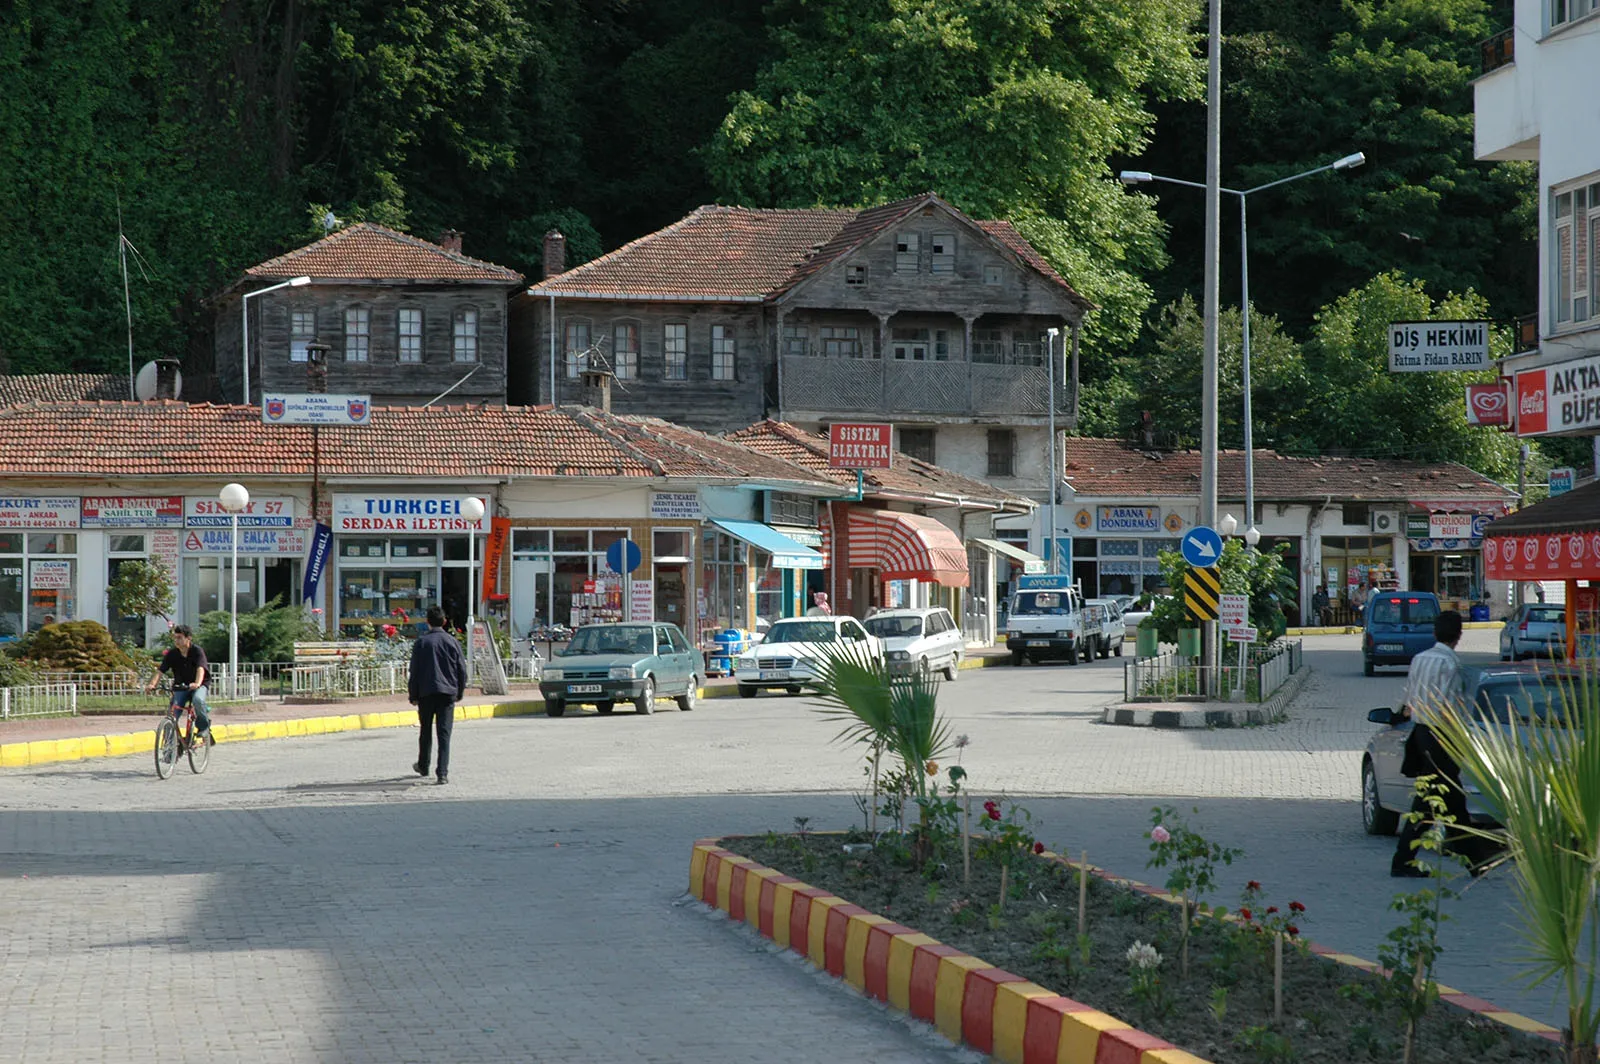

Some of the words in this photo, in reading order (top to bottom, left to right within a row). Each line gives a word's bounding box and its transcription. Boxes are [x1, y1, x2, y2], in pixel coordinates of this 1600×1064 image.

[1394, 326, 1419, 351] DİŞ
[1427, 324, 1483, 347] HEKİMİ
[1394, 354, 1421, 366] Fatma
[1424, 352, 1449, 365] Fidan
[1451, 351, 1484, 365] BARIN
[1552, 365, 1600, 396] AKTA
[264, 502, 283, 514] 57
[1113, 508, 1144, 518] ABANA
[29, 511, 58, 519] ANKARA
[342, 517, 407, 530] SERDAR
[1101, 519, 1159, 528] DONDURMASI
[243, 531, 277, 544] EMLAK
[310, 532, 330, 584] TURKCELL
[1028, 578, 1059, 586] AYGAZ
